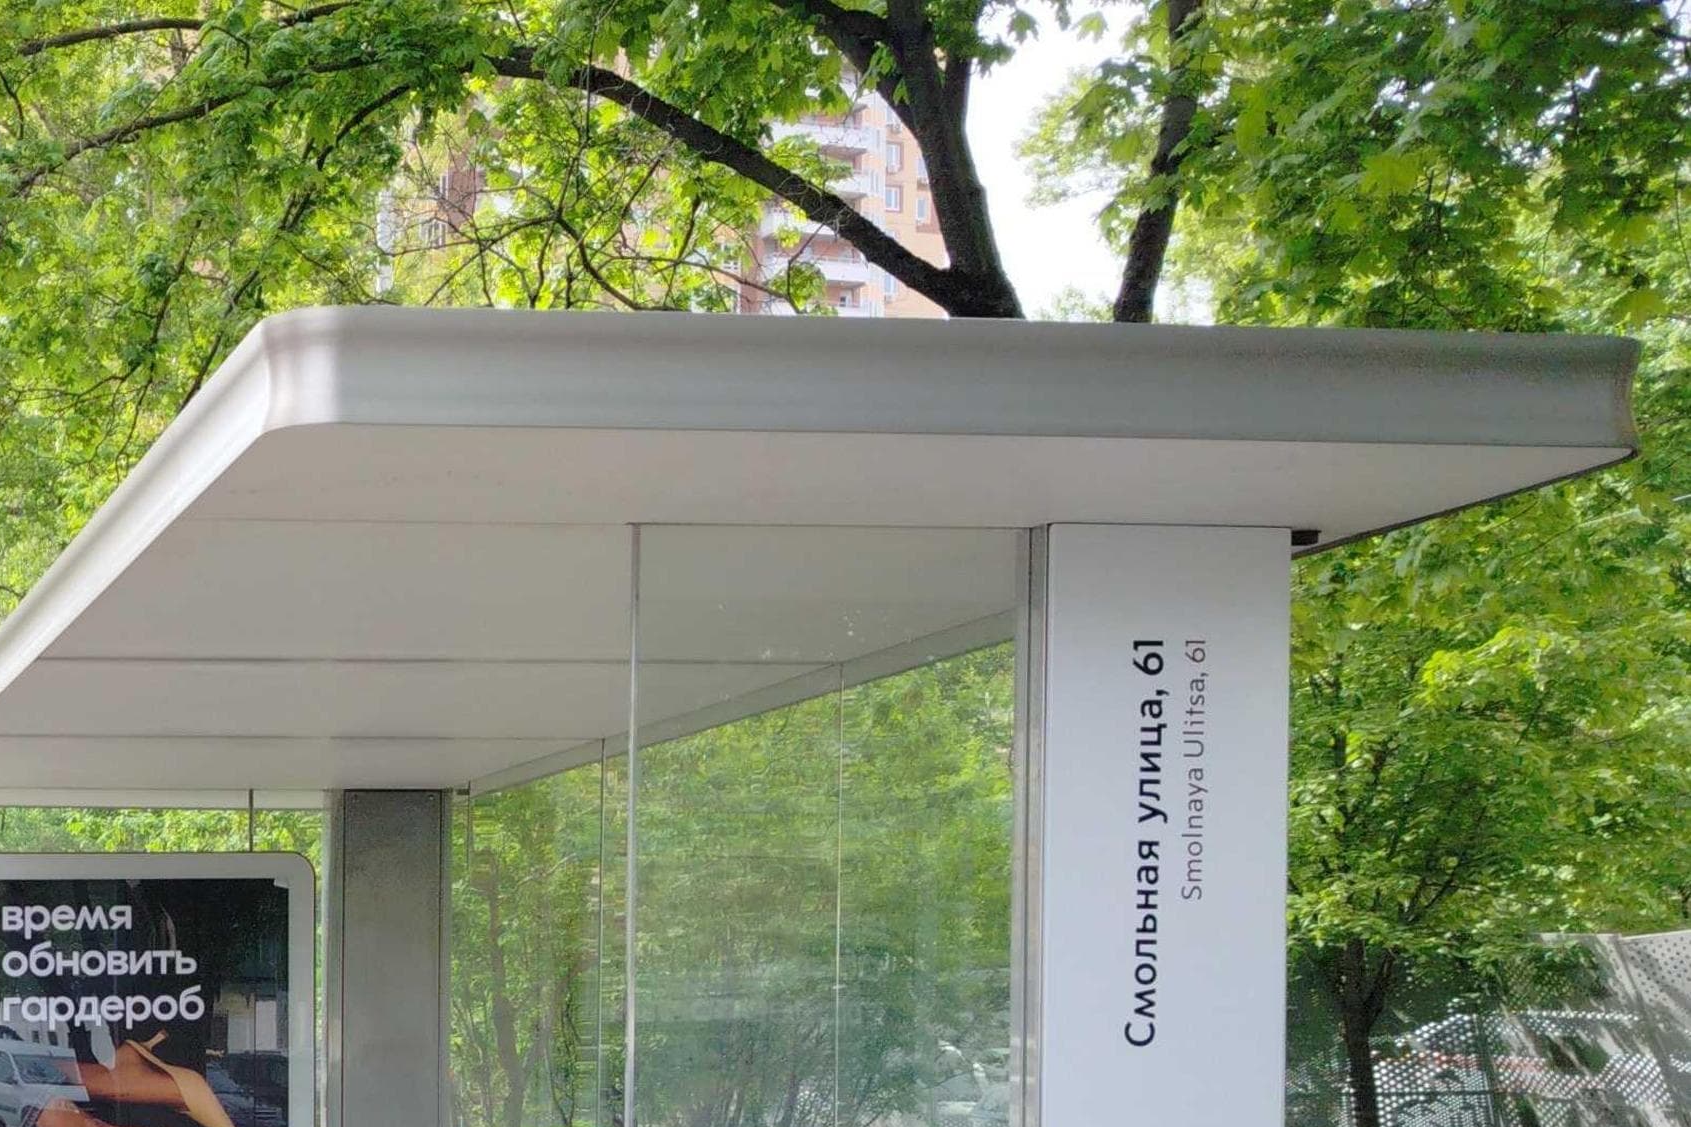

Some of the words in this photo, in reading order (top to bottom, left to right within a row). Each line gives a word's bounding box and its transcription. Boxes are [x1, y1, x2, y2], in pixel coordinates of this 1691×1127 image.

[1132, 639, 1165, 677] 61
[1184, 639, 1207, 664] 61
[1182, 672, 1210, 758] Ulitsa,
[1137, 688, 1170, 825] улица,
[1181, 766, 1209, 901] Smolnaya
[1, 904, 133, 940] время
[1124, 839, 1161, 1048] Смольная
[1, 940, 198, 978] обновить
[1, 984, 206, 1030] гардероб
